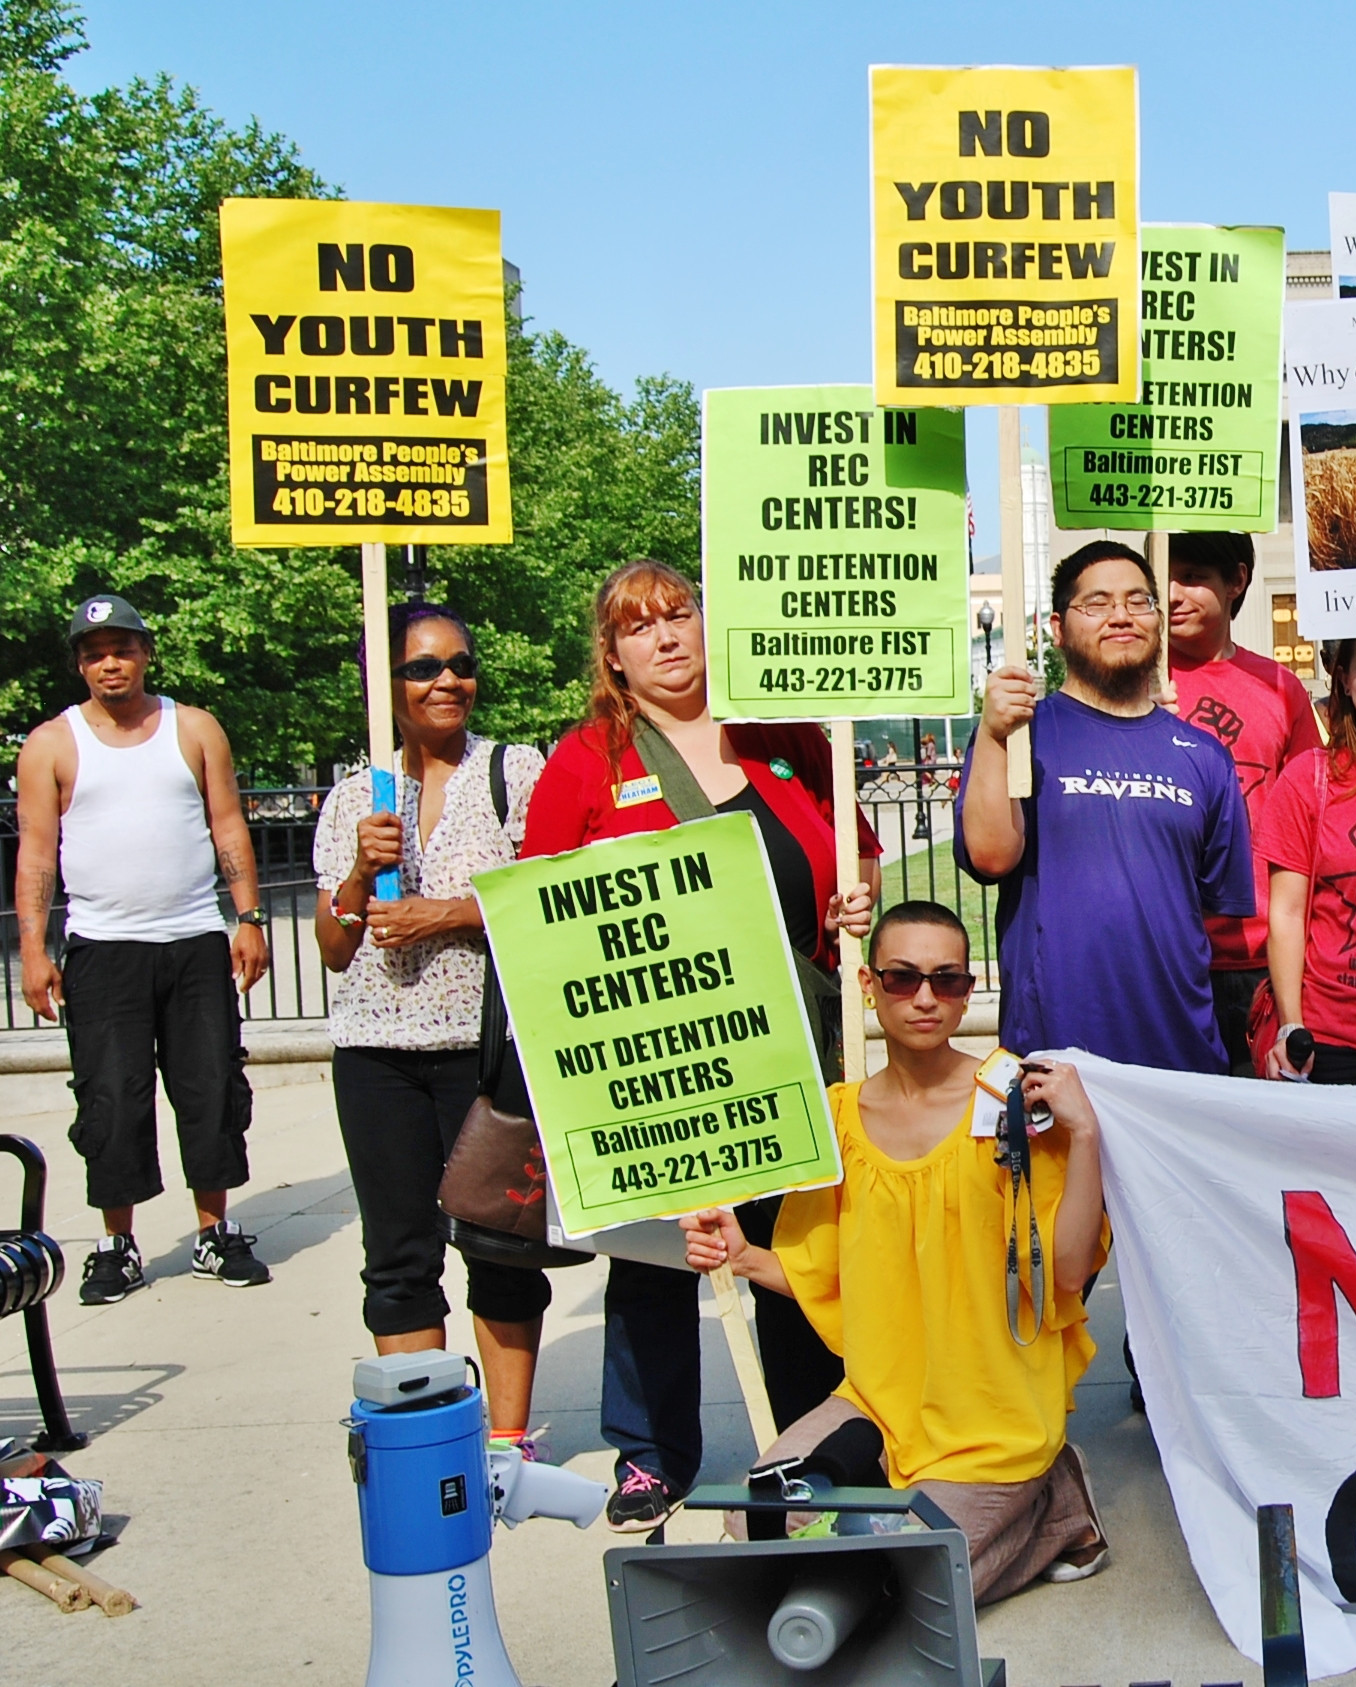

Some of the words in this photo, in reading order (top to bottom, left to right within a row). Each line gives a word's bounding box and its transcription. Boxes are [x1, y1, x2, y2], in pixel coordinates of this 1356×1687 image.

[959, 110, 1050, 158] NO
[893, 181, 1115, 221] YOUTH
[318, 242, 414, 292] NO
[899, 241, 1116, 280] CURFEW
[1142, 251, 1201, 282] EST
[1210, 253, 1239, 282] IN
[903, 306, 1013, 326] Baltimore
[1018, 304, 1110, 328] People's
[1143, 290, 1194, 321] REC
[250, 314, 483, 358] YOUTH
[918, 326, 986, 347] Power
[991, 325, 1097, 346] Assembly
[1142, 330, 1235, 361] NTERS!
[913, 350, 1100, 379] 410-218-4835
[1292, 364, 1349, 389] Why
[255, 374, 482, 417] CURFEW
[1143, 381, 1252, 408] ETENTION
[760, 411, 873, 445] INVEST
[884, 412, 916, 445] IN
[1110, 414, 1213, 440] CENTERS
[261, 441, 377, 462] Baltimore
[384, 443, 478, 466] People's
[1084, 451, 1191, 476] Baltimore
[1199, 454, 1242, 476] FIST
[277, 462, 350, 482] Power
[355, 462, 465, 486] Assembly
[809, 453, 869, 487] REC
[273, 488, 470, 518] 410-218-4835
[1090, 484, 1232, 509] 443-221-3775
[762, 496, 916, 530] CENTERS!
[738, 555, 790, 581] NOT
[798, 554, 937, 581] DETENTION
[781, 590, 896, 617] CENTERS
[751, 632, 873, 656] Baltimore
[881, 631, 930, 655] FIST
[759, 667, 922, 692] 443-221-3775
[1058, 776, 1193, 806] RAVENS
[1085, 769, 1172, 783] BALTIMORE
[538, 862, 660, 924] INVEST
[670, 852, 713, 896] IN
[598, 912, 669, 962] REC
[563, 948, 735, 1019] CENTERS!
[555, 1041, 607, 1078] NOT
[614, 1005, 770, 1067] DETENTION
[608, 1056, 734, 1110] CENTERS
[591, 1110, 719, 1156] Baltimore
[724, 1092, 780, 1130] FIST
[611, 1134, 782, 1194] 443-221-3775
[1011, 1151, 1021, 1171] BIG
